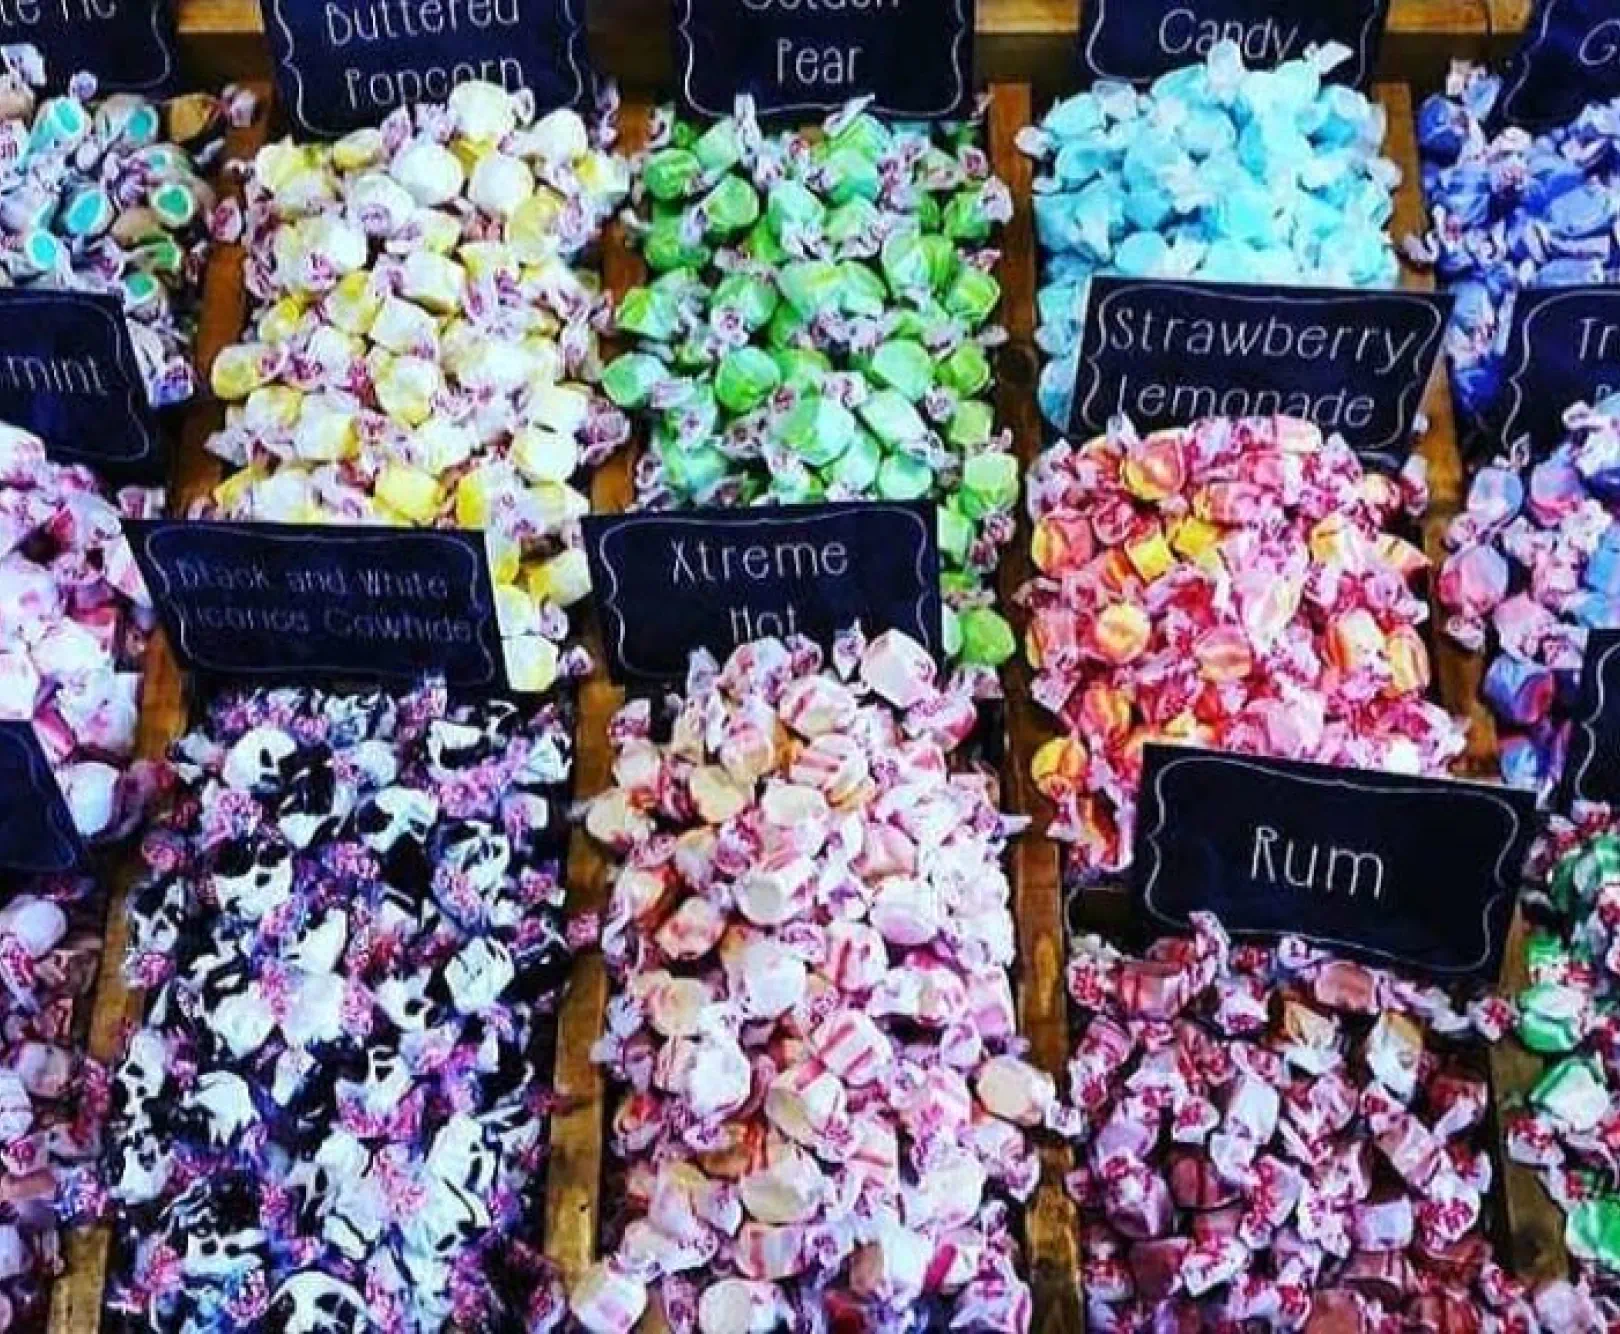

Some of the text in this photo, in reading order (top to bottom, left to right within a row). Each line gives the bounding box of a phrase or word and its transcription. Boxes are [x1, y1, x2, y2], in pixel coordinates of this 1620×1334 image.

[1158, 8, 1299, 60] Candy
[344, 58, 525, 110] Popcorn
[776, 36, 864, 86] Pear
[1110, 306, 1417, 375] Strawberry
[1117, 374, 1376, 427] Lemonade
[671, 539, 849, 584] Xtreme
[1251, 825, 1384, 899] Rum
